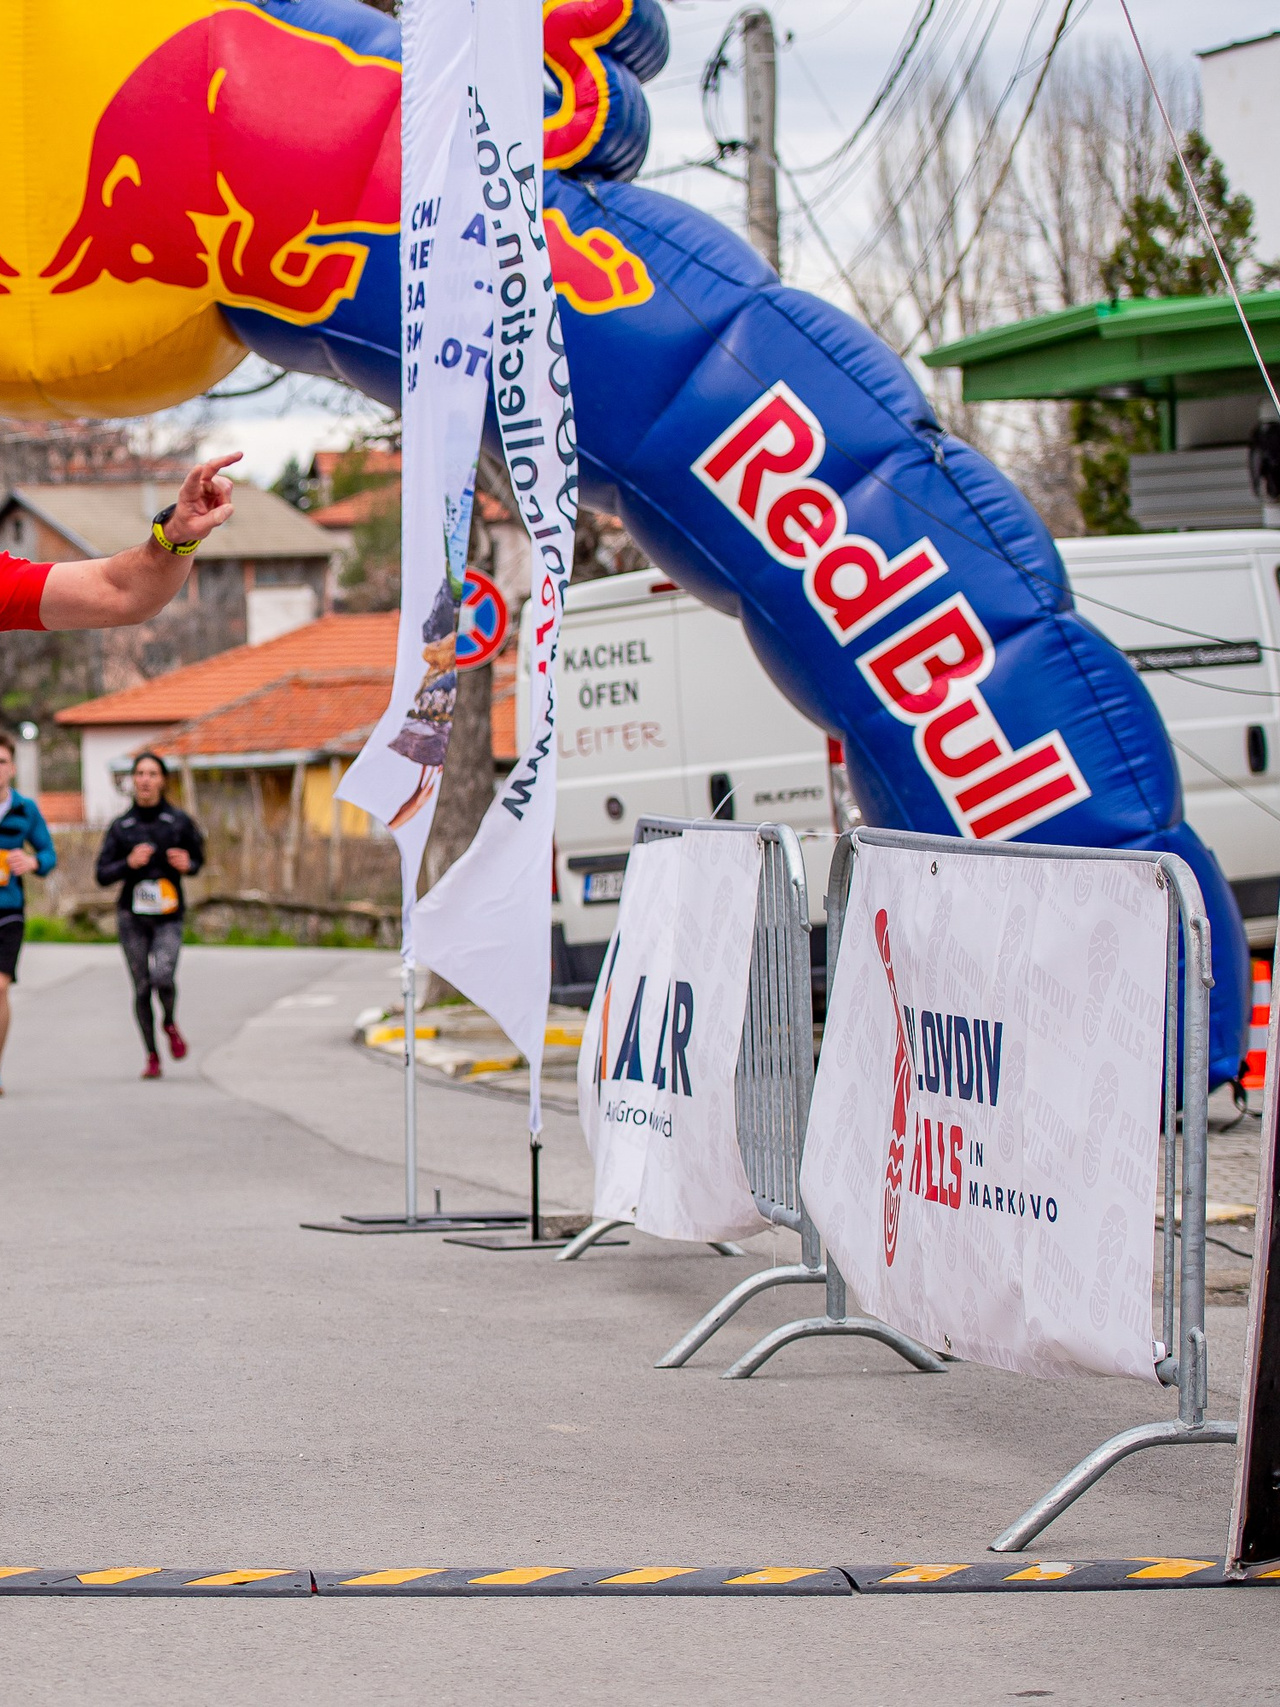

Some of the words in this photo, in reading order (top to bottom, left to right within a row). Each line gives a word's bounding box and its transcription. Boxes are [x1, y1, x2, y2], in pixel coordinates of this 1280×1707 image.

[705, 395, 934, 631] Red
[869, 606, 1077, 839] Bull
[563, 640, 653, 673] KACHEL
[578, 680, 640, 710] ÖFEN
[1117, 968, 1163, 1033] PLOVD
[967, 1140, 984, 1167] IN
[1118, 1109, 1157, 1165] PLOV
[969, 1180, 1059, 1224] MARKOVO
[1118, 1290, 1149, 1344] HILL
